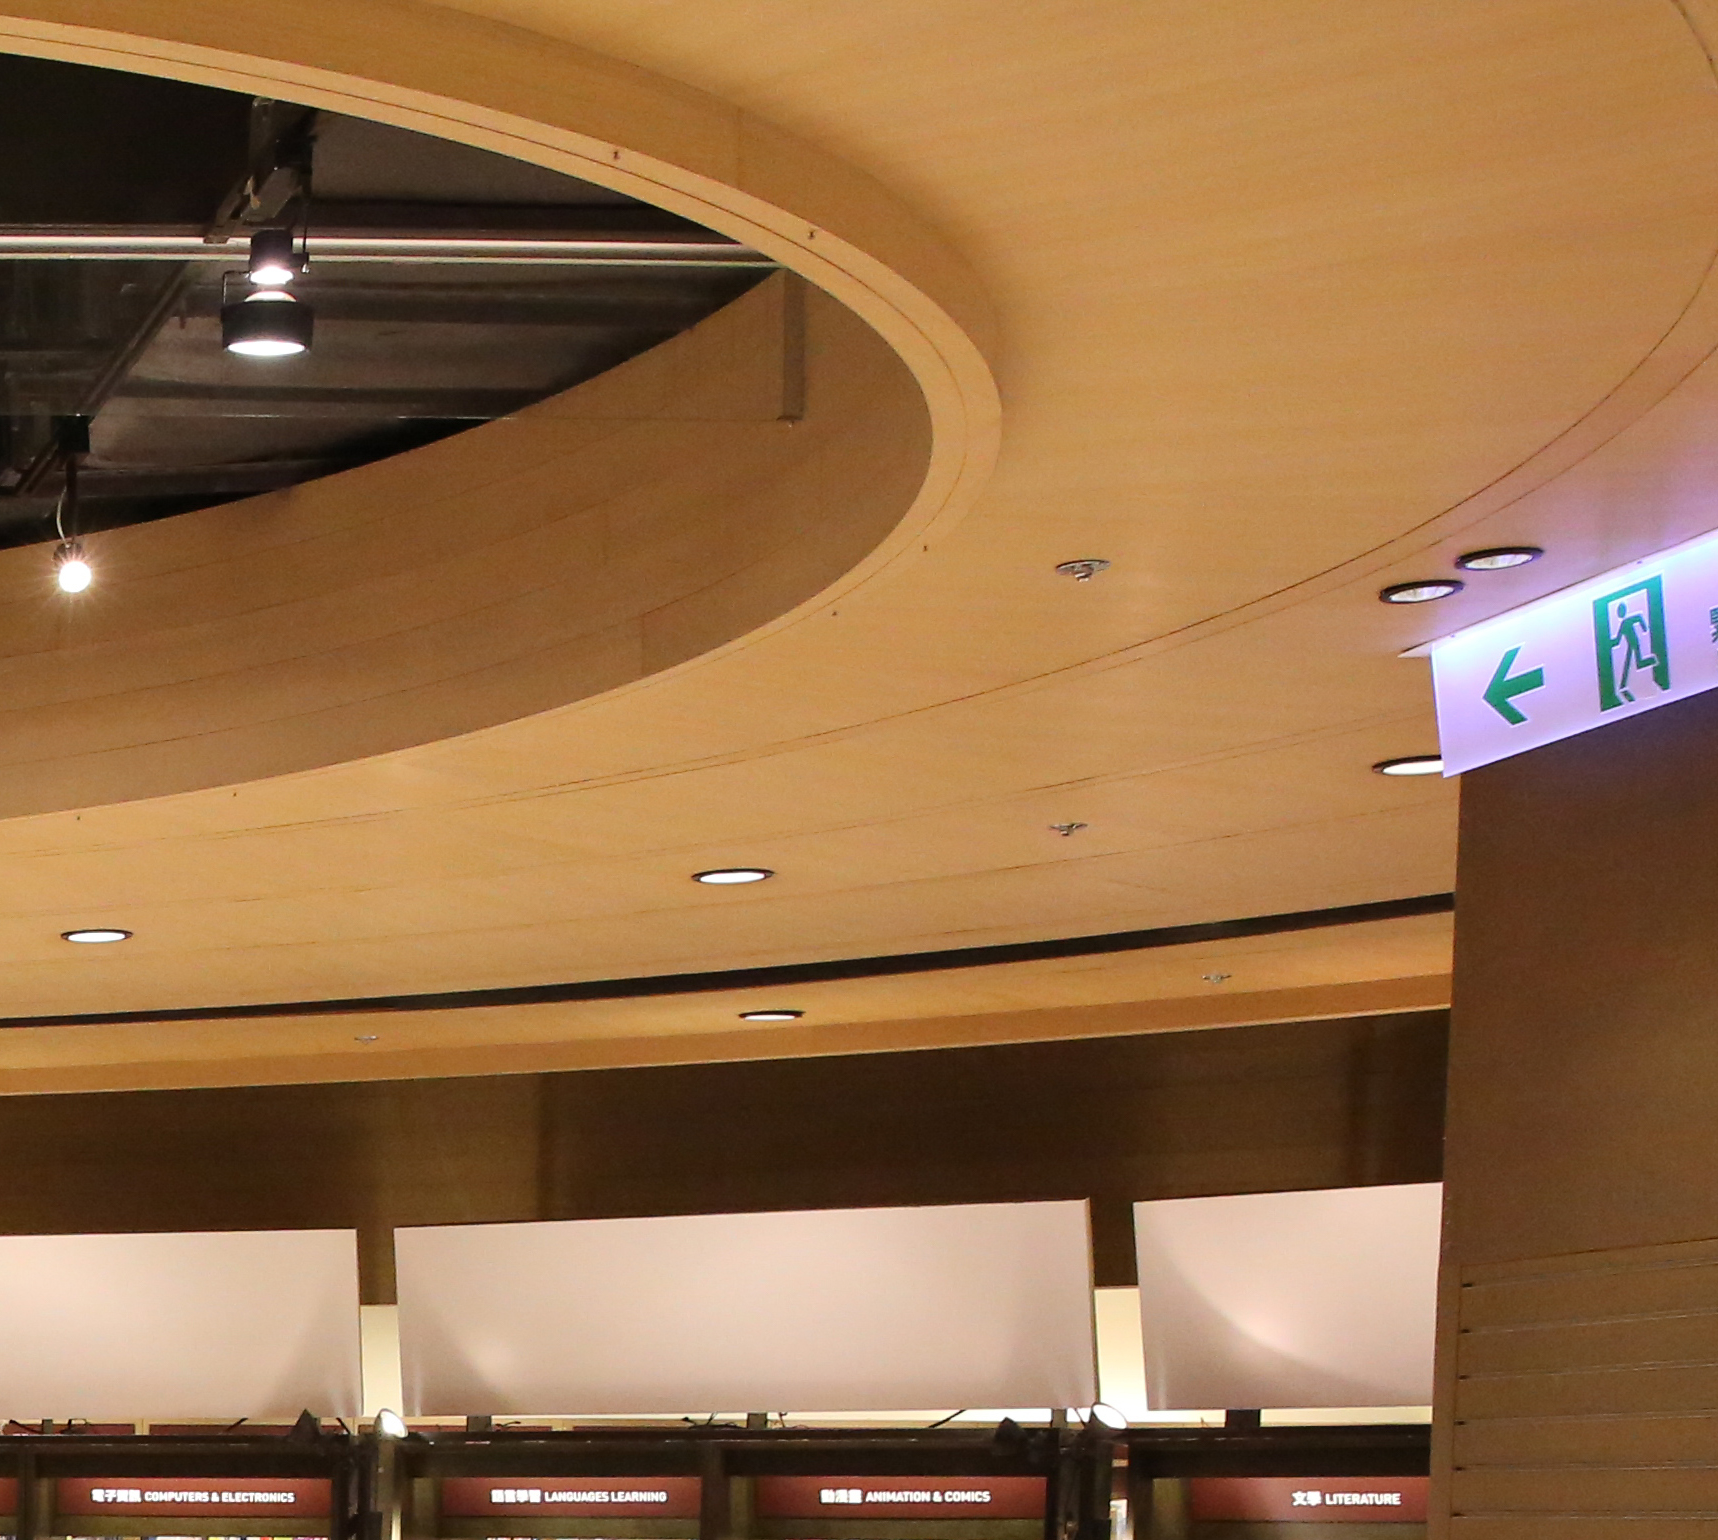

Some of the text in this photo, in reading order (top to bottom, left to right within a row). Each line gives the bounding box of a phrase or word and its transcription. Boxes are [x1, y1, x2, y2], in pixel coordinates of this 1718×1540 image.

[144, 1491, 210, 1503] COMPUTERS
[211, 1491, 220, 1503] &
[221, 1491, 296, 1503] ELECTRONICS
[544, 1490, 609, 1502] LANGUAGES
[610, 1490, 668, 1502] LEARNING
[865, 1490, 992, 1502] ANIMATION & COMICS
[1324, 1492, 1402, 1505] LITERATURE
